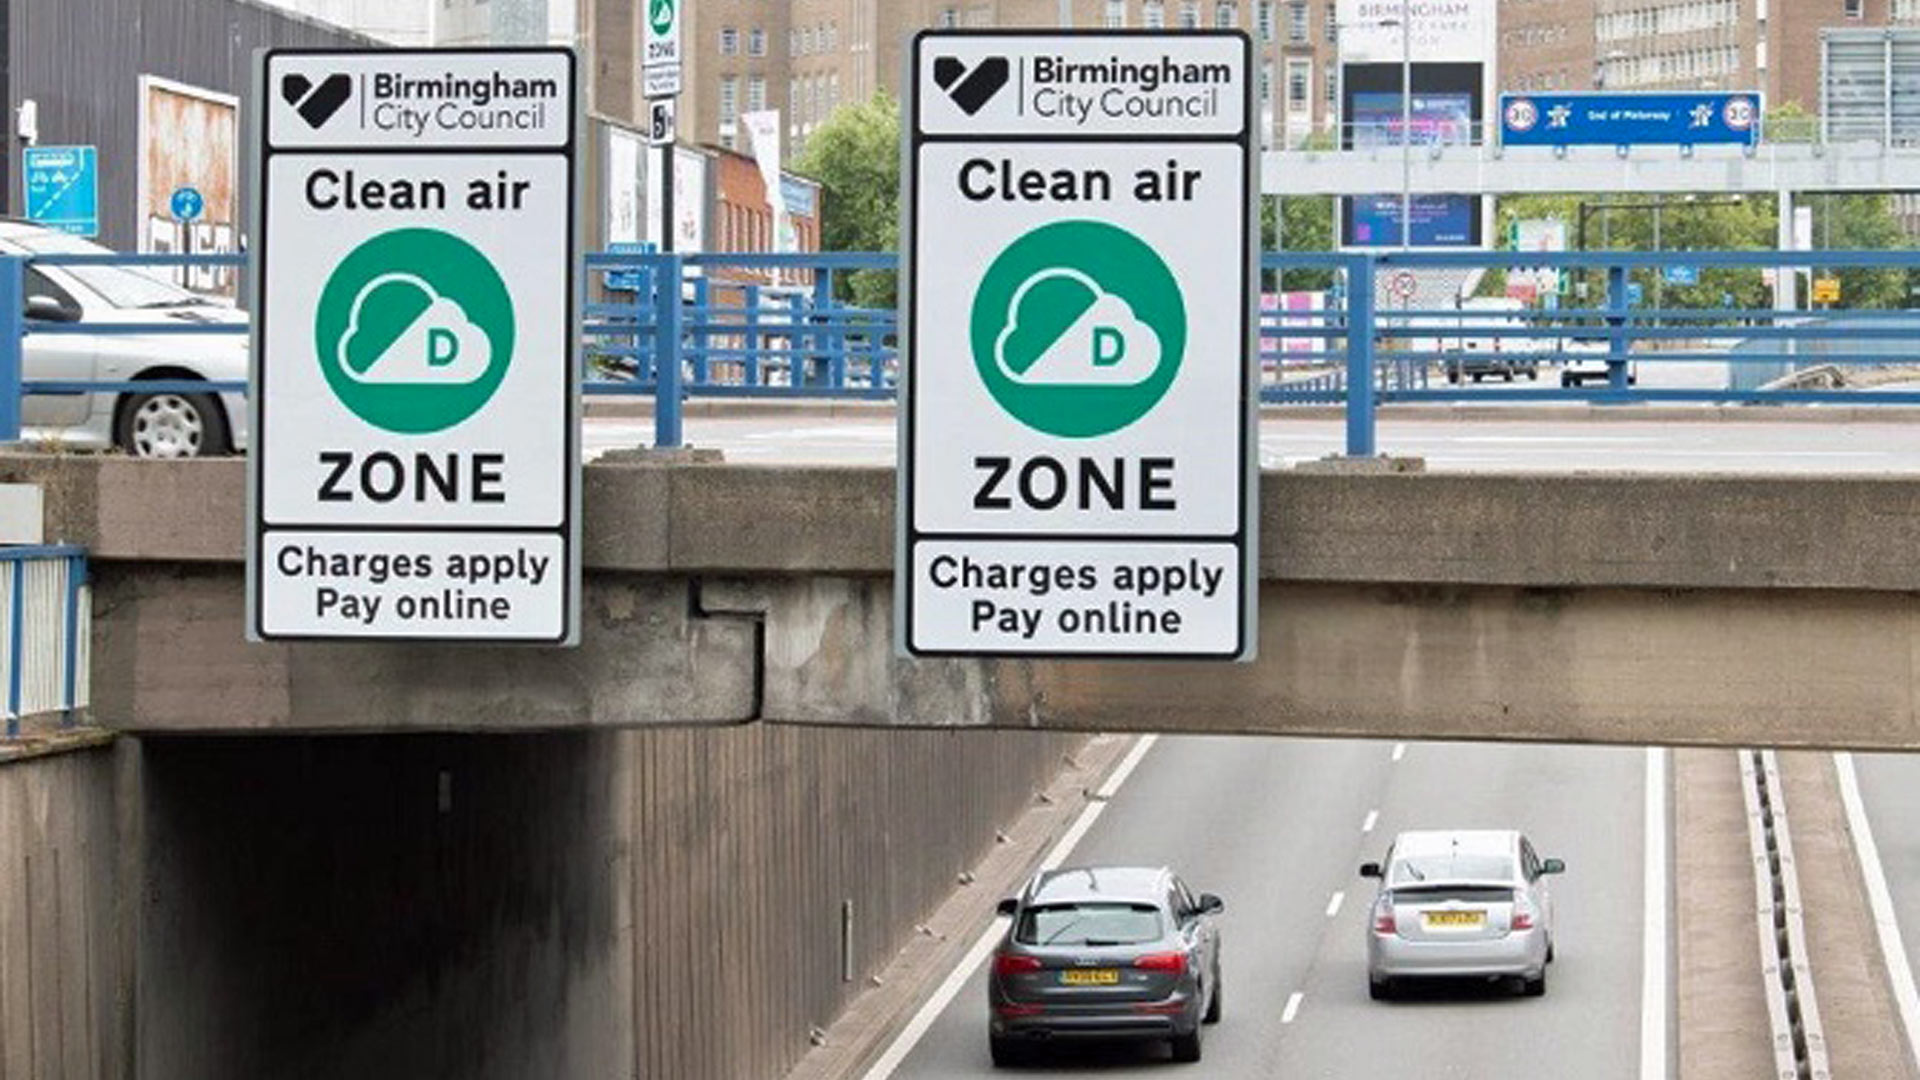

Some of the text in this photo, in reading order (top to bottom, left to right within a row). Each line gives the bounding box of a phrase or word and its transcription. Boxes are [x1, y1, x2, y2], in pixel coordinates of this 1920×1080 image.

[1358, 4, 1469, 17] BIRMNGHAM
[374, 71, 556, 106] Birmingham
[1033, 56, 1230, 92] Birmingham
[374, 102, 545, 137] City Council
[1033, 87, 1217, 125] City Council
[305, 168, 531, 211] Clean air
[958, 157, 1202, 202] Clean air
[428, 327, 459, 367] D
[1093, 326, 1126, 367] D
[317, 450, 506, 504] ZONE
[973, 455, 1177, 511] ZONE
[277, 545, 550, 586] Charges apply
[928, 554, 1224, 598] Charges apply
[316, 588, 511, 624] Pay online
[971, 600, 1182, 640] Pay online
